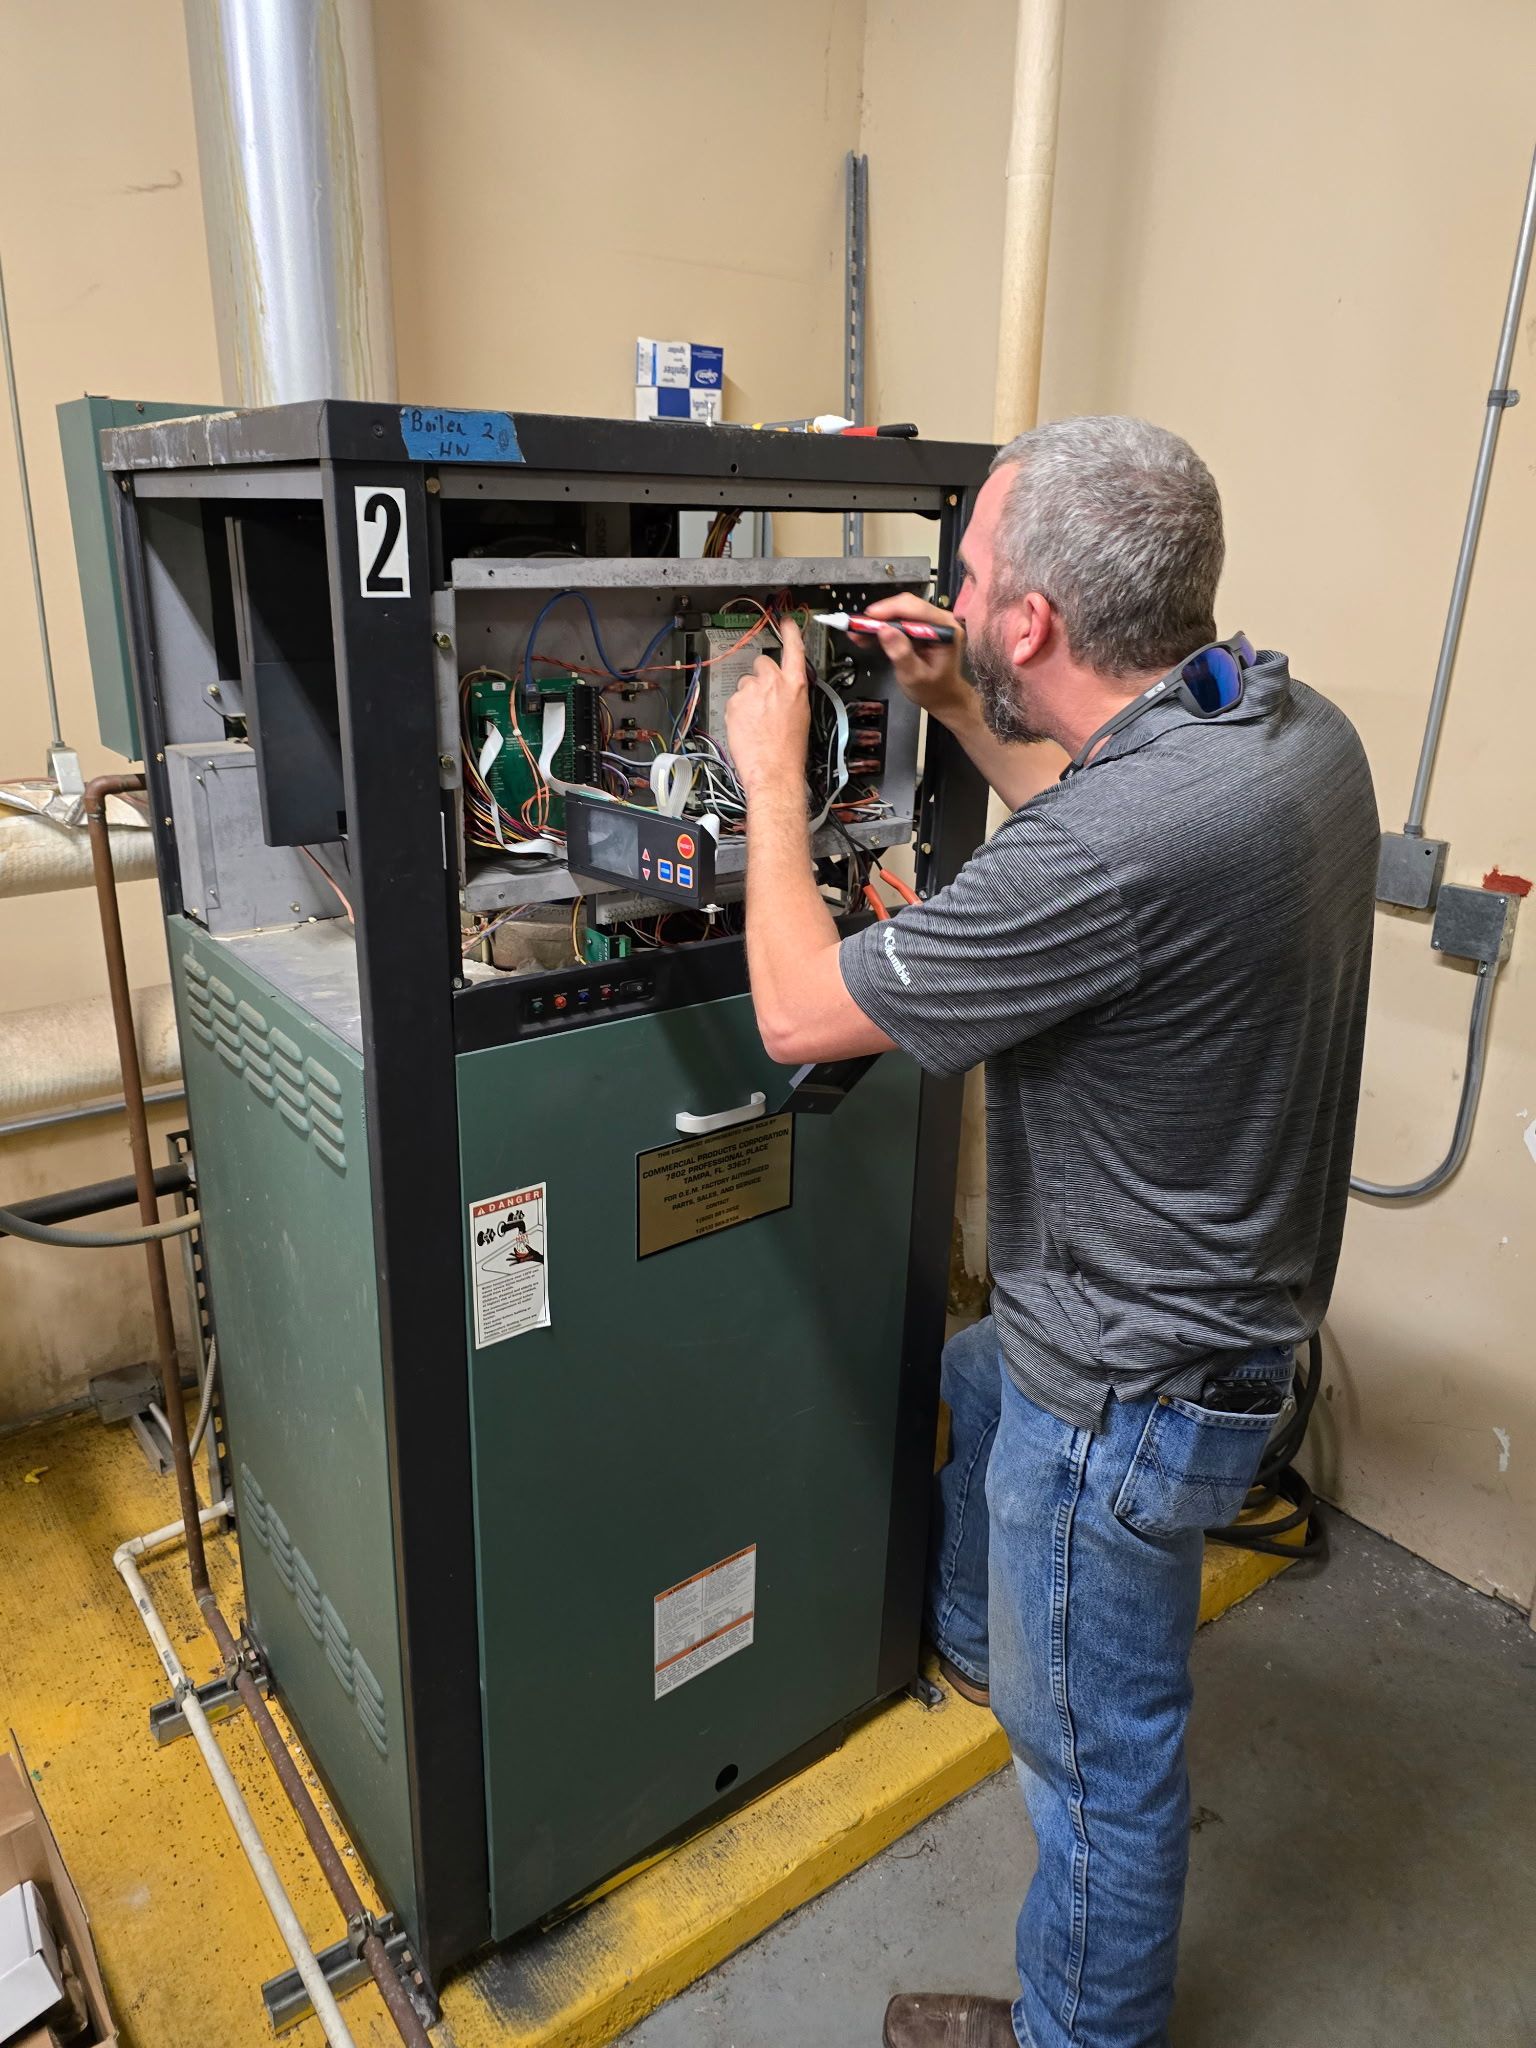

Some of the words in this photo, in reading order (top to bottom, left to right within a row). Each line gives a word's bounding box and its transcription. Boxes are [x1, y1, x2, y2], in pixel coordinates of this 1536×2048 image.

[411, 409, 466, 436] Boiler
[481, 422, 495, 440] 2
[364, 493, 403, 592] 2
[642, 1156, 695, 1179] COMMERCIAL
[697, 1143, 736, 1161] PRODUCTS
[738, 1127, 788, 1148] CORPORATION
[665, 1169, 685, 1181] 7802
[688, 1150, 743, 1173] PROFESSIONAL
[746, 1142, 768, 1155] PLACE
[664, 1193, 676, 1203] FOR
[701, 1176, 729, 1190] FACTORY
[731, 1163, 769, 1181] AUTHORIZED
[684, 1169, 711, 1184] TAMPA,
[720, 1184, 734, 1194] AND
[735, 1176, 761, 1189] SERVICE
[488, 1191, 540, 1213] DANGER
[705, 1197, 728, 1210] CONTACT
